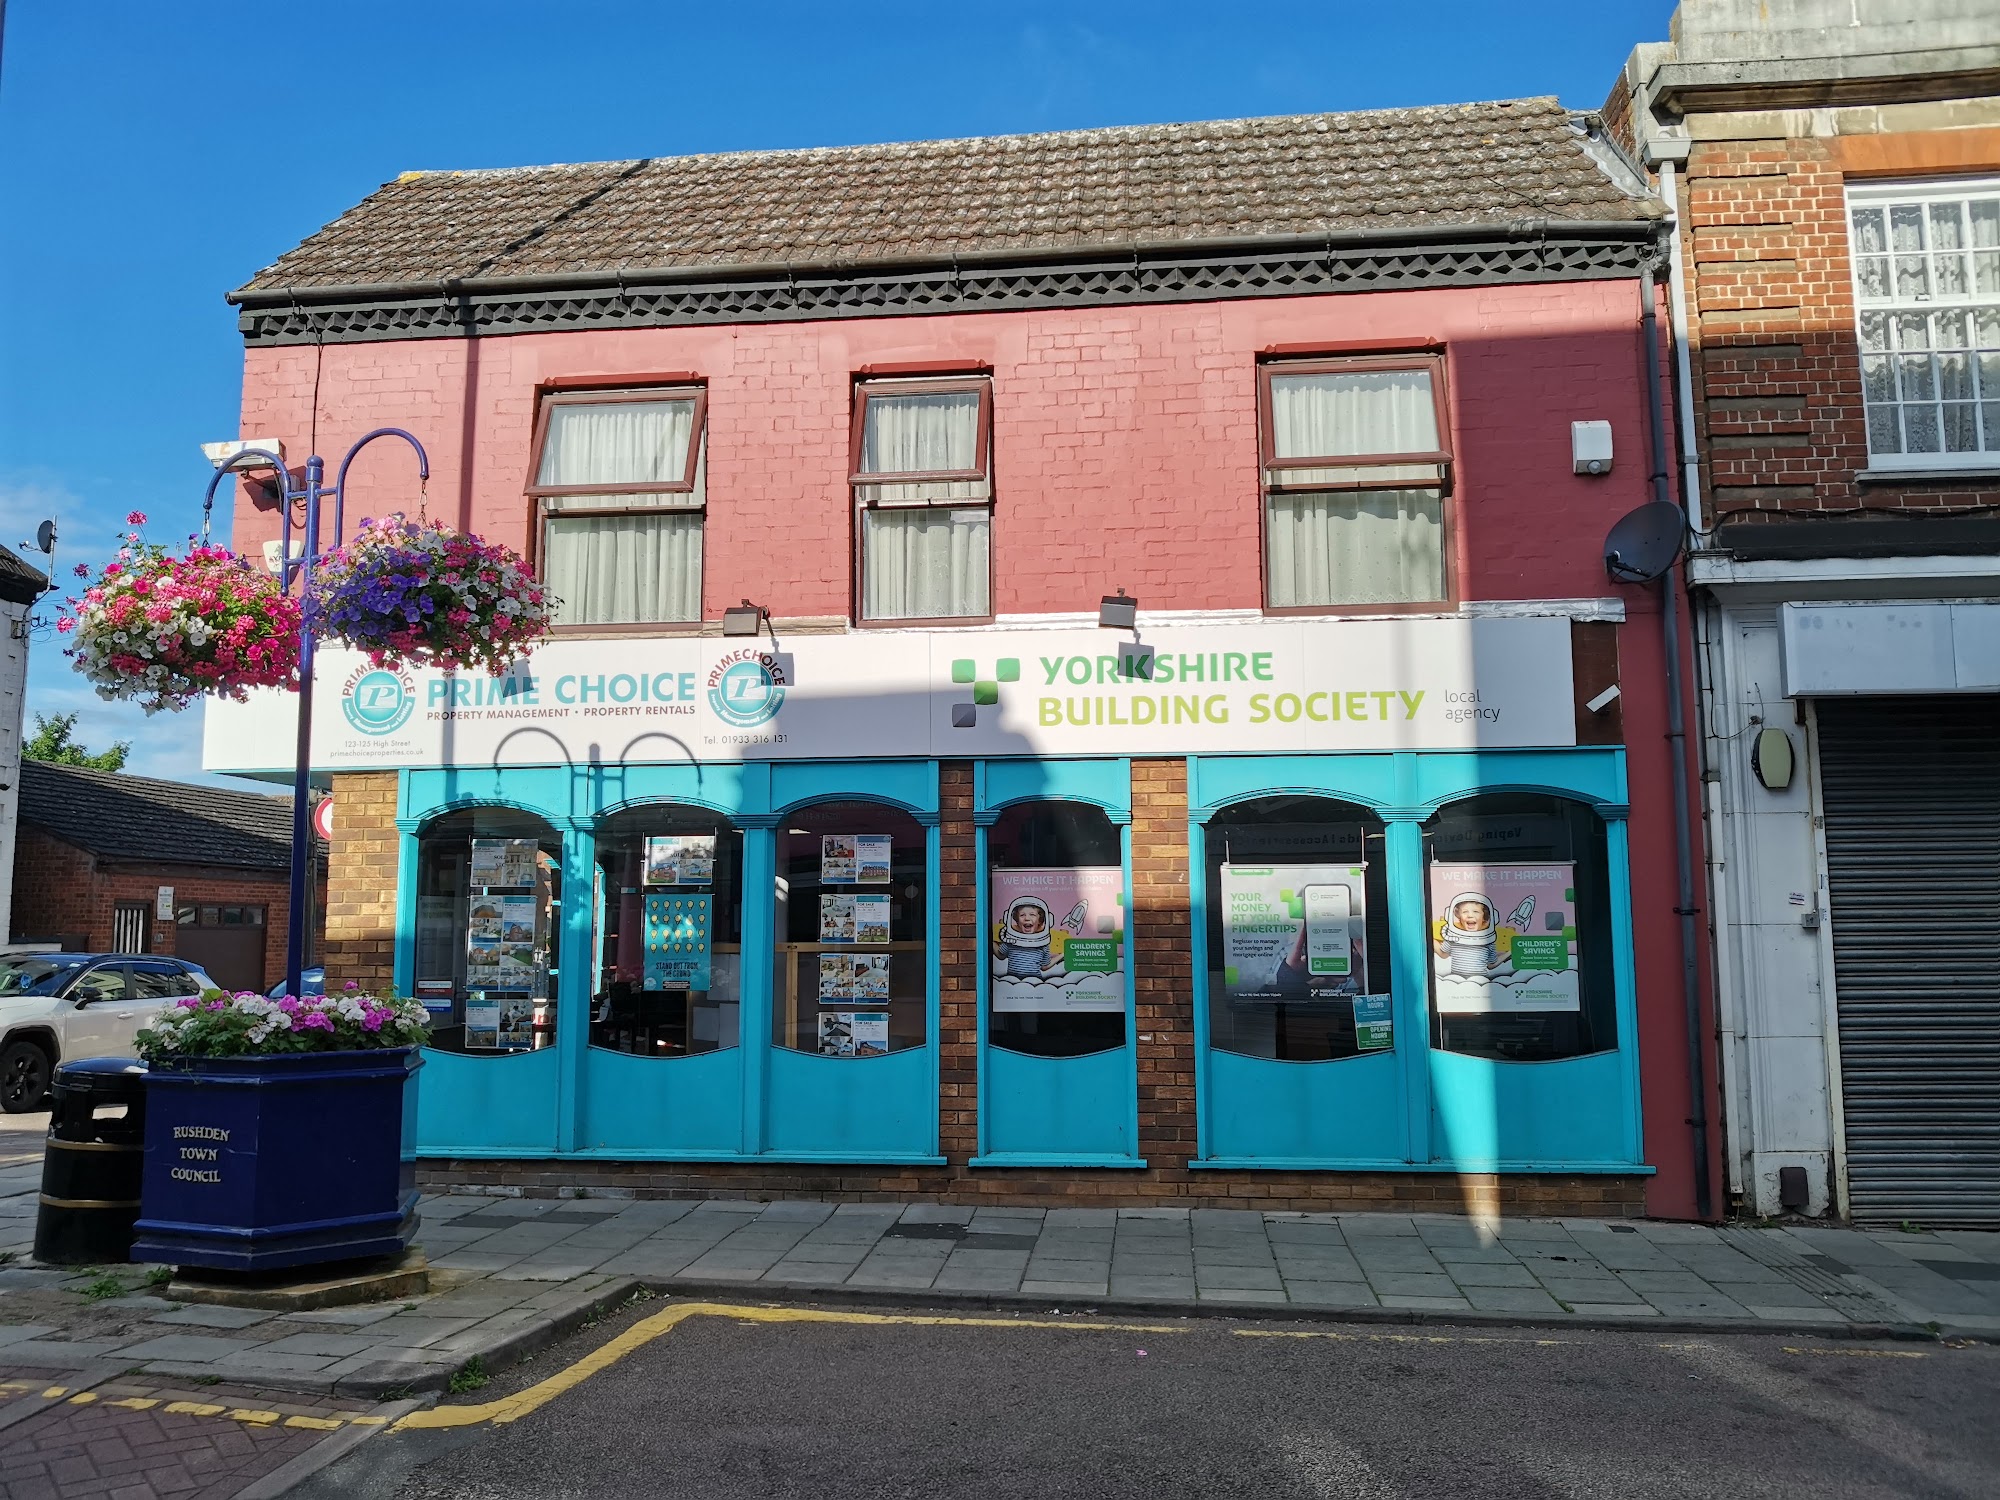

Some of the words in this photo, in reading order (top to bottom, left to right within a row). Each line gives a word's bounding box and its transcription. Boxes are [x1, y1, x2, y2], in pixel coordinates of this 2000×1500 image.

[708, 648, 785, 688] PRIMECHOICE
[1039, 652, 1274, 685] YORKSHIRE
[427, 676, 540, 707] PRIME
[555, 672, 695, 704] CHOICE
[1445, 689, 1481, 703] local
[427, 711, 483, 721] PROPERTY
[487, 708, 570, 719] MANAGEMENT
[584, 706, 641, 716] PROPERTY
[646, 705, 696, 715] RENTALS
[1039, 694, 1229, 726] BUILDING
[1249, 690, 1425, 723] SOCIETY
[1445, 708, 1500, 723] agency
[704, 736, 718, 744] Tel.
[722, 736, 749, 744] 01933
[753, 735, 769, 743] 316
[774, 735, 788, 743] 131
[330, 749, 424, 758] primechoiceproperties.co.uk
[1003, 876, 1020, 885] WE
[1023, 876, 1053, 885] MAKE
[1057, 876, 1066, 885] IT
[1070, 875, 1114, 884] HAPPEN
[1441, 871, 1460, 880] WE
[1463, 871, 1497, 880] MAKE
[1500, 871, 1511, 879] IT
[1514, 871, 1562, 879] HAPPEN
[1231, 893, 1261, 901] YOUR
[1232, 904, 1271, 912] MONEY
[1232, 914, 1246, 922] AT
[1250, 914, 1280, 922] YOUR
[1232, 924, 1297, 933] FINGERTIPS
[173, 1126, 230, 1142] RUSHDEN
[179, 1147, 219, 1161] TOWN
[171, 1167, 221, 1183] COUNCIL
